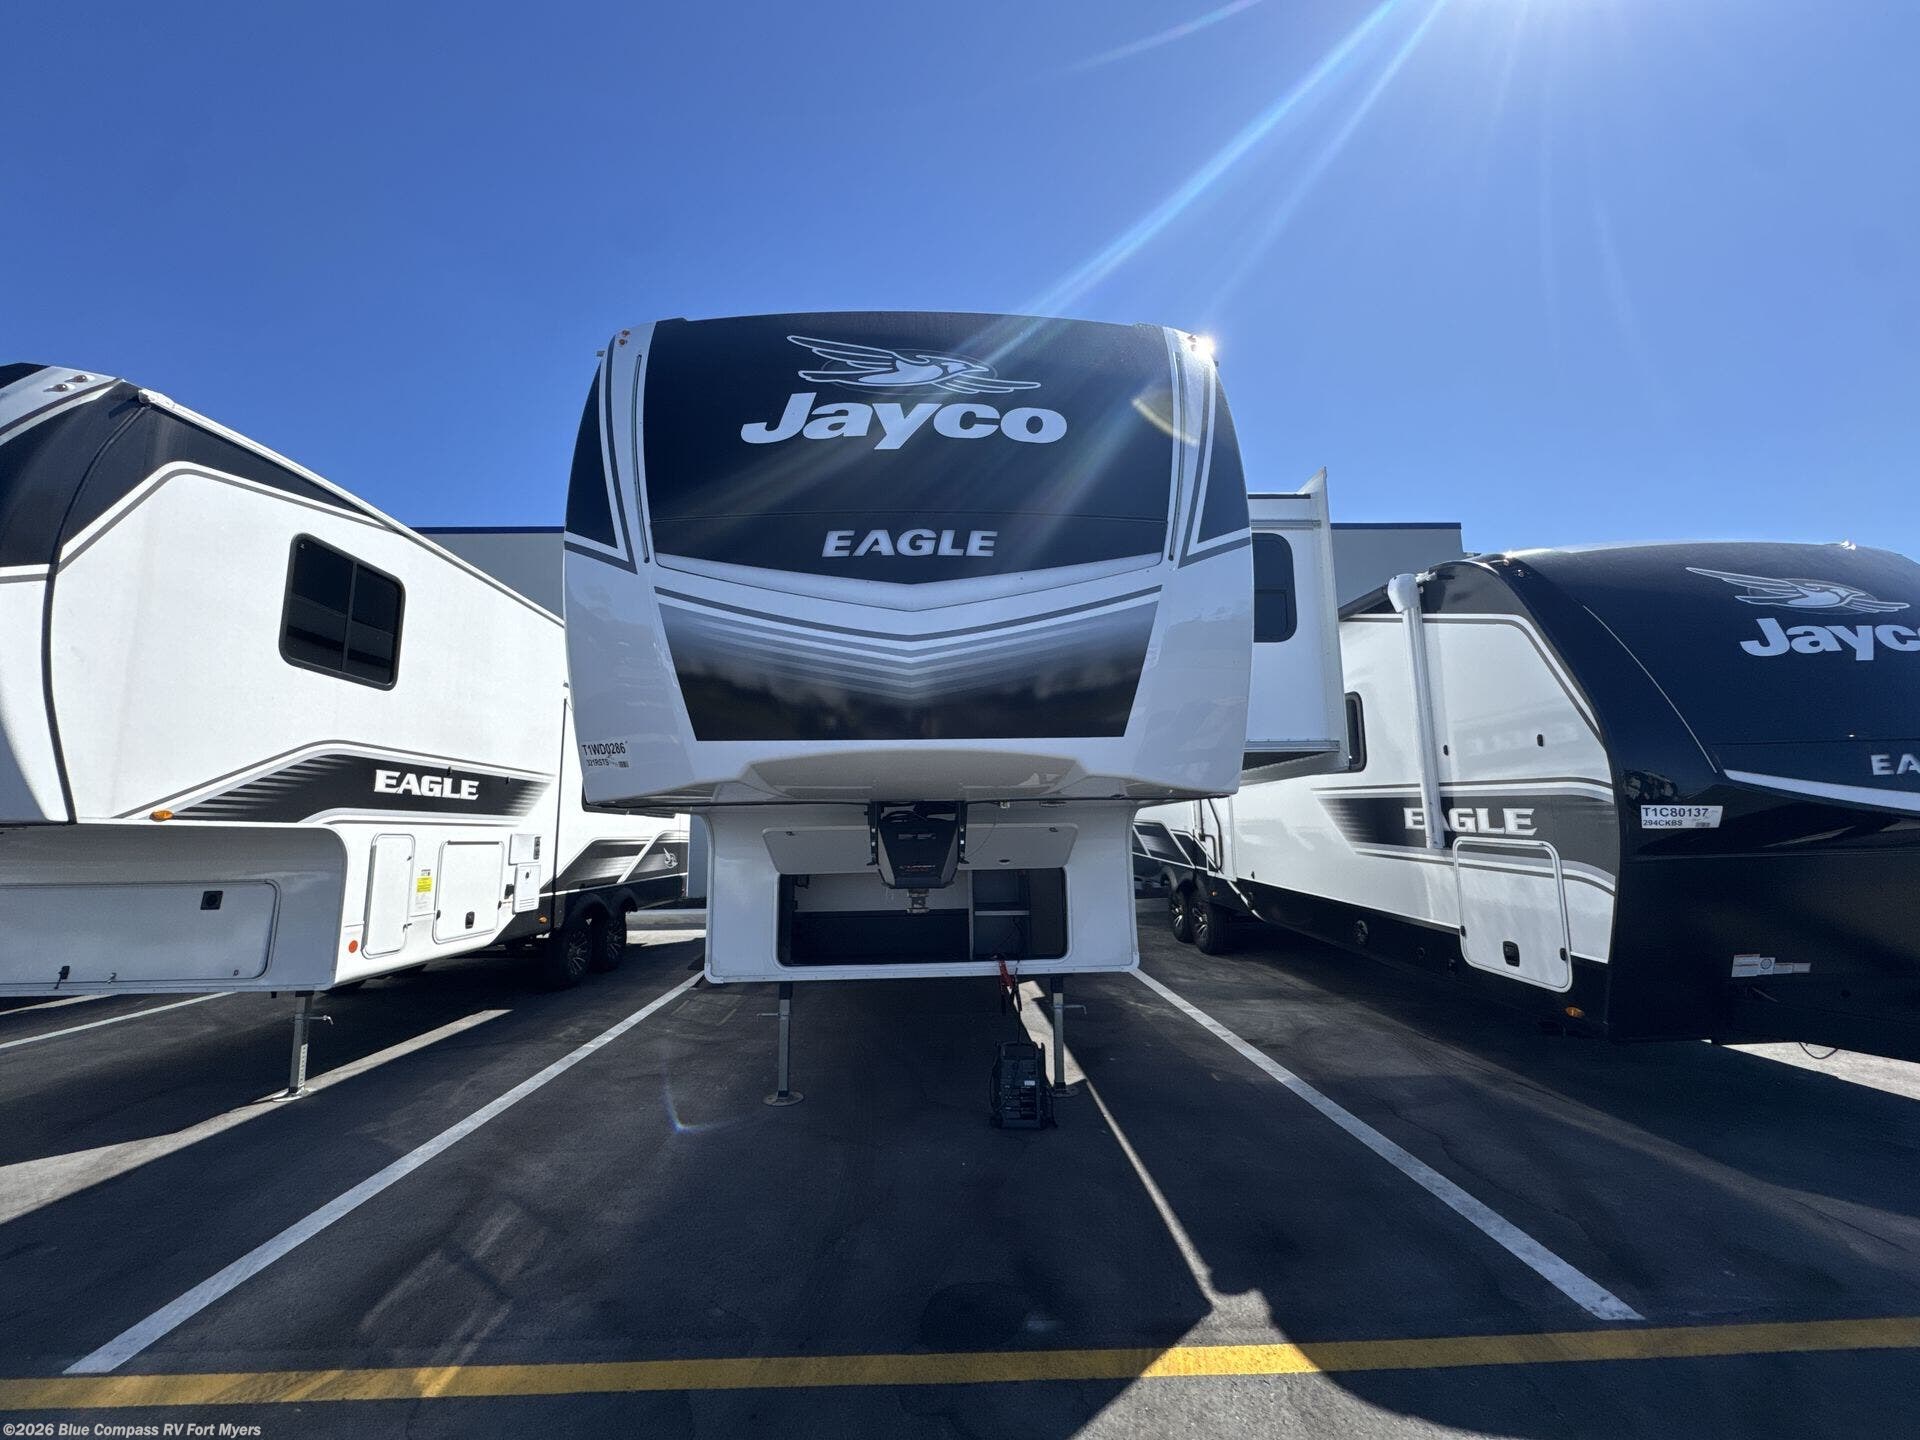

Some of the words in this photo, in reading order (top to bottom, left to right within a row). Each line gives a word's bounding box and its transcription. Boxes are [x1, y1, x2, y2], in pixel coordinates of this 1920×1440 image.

[741, 392, 1067, 450] Jayco
[822, 529, 998, 558] EAGLE
[1739, 617, 1920, 661] Jayc
[374, 769, 480, 801] EAGLE
[1404, 807, 1538, 836] EGLE
[1642, 807, 1709, 818] T1C80137
